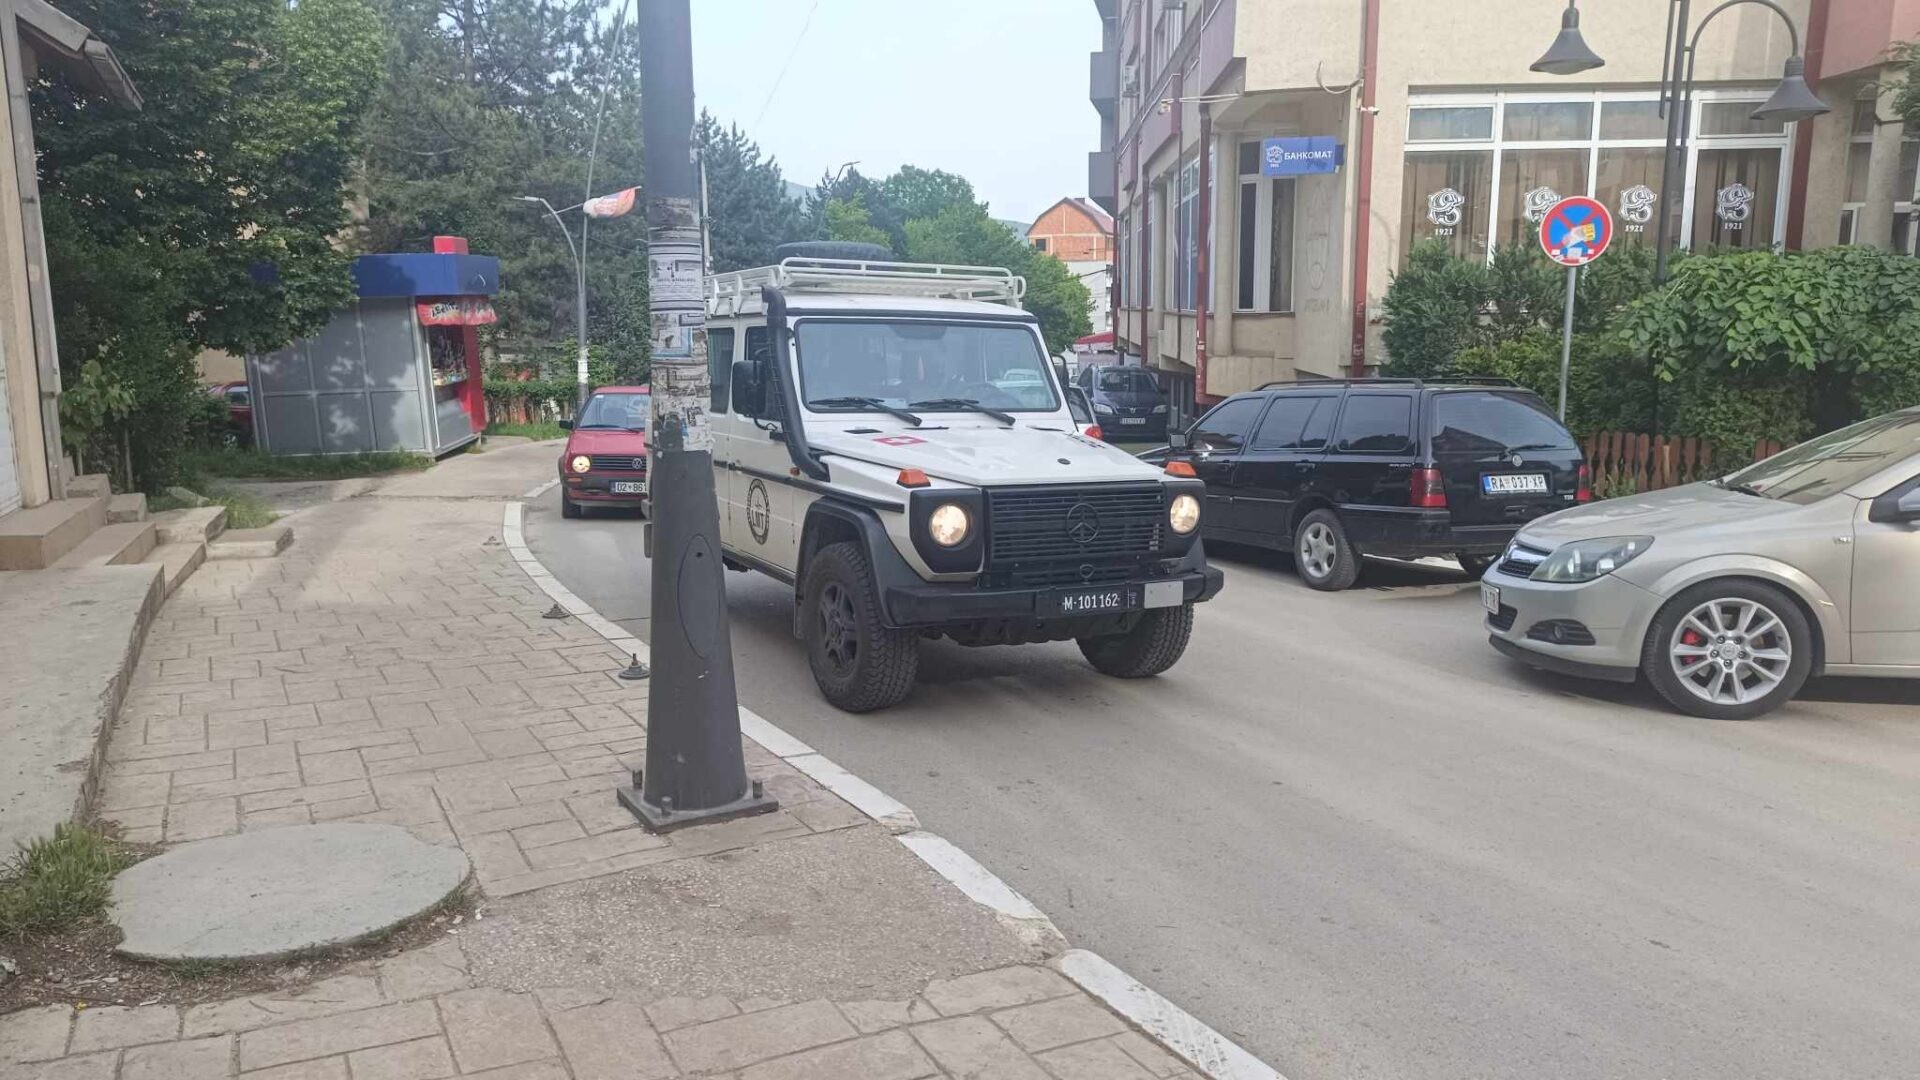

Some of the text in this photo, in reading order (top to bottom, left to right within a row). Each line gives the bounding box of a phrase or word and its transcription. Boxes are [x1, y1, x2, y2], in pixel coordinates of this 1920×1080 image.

[1284, 150, 1332, 160] БАНКОМАТ
[1624, 224, 1644, 232] 1921
[1724, 222, 1742, 230] 1921
[1434, 228, 1453, 236] 1921
[1491, 477, 1505, 489] RA
